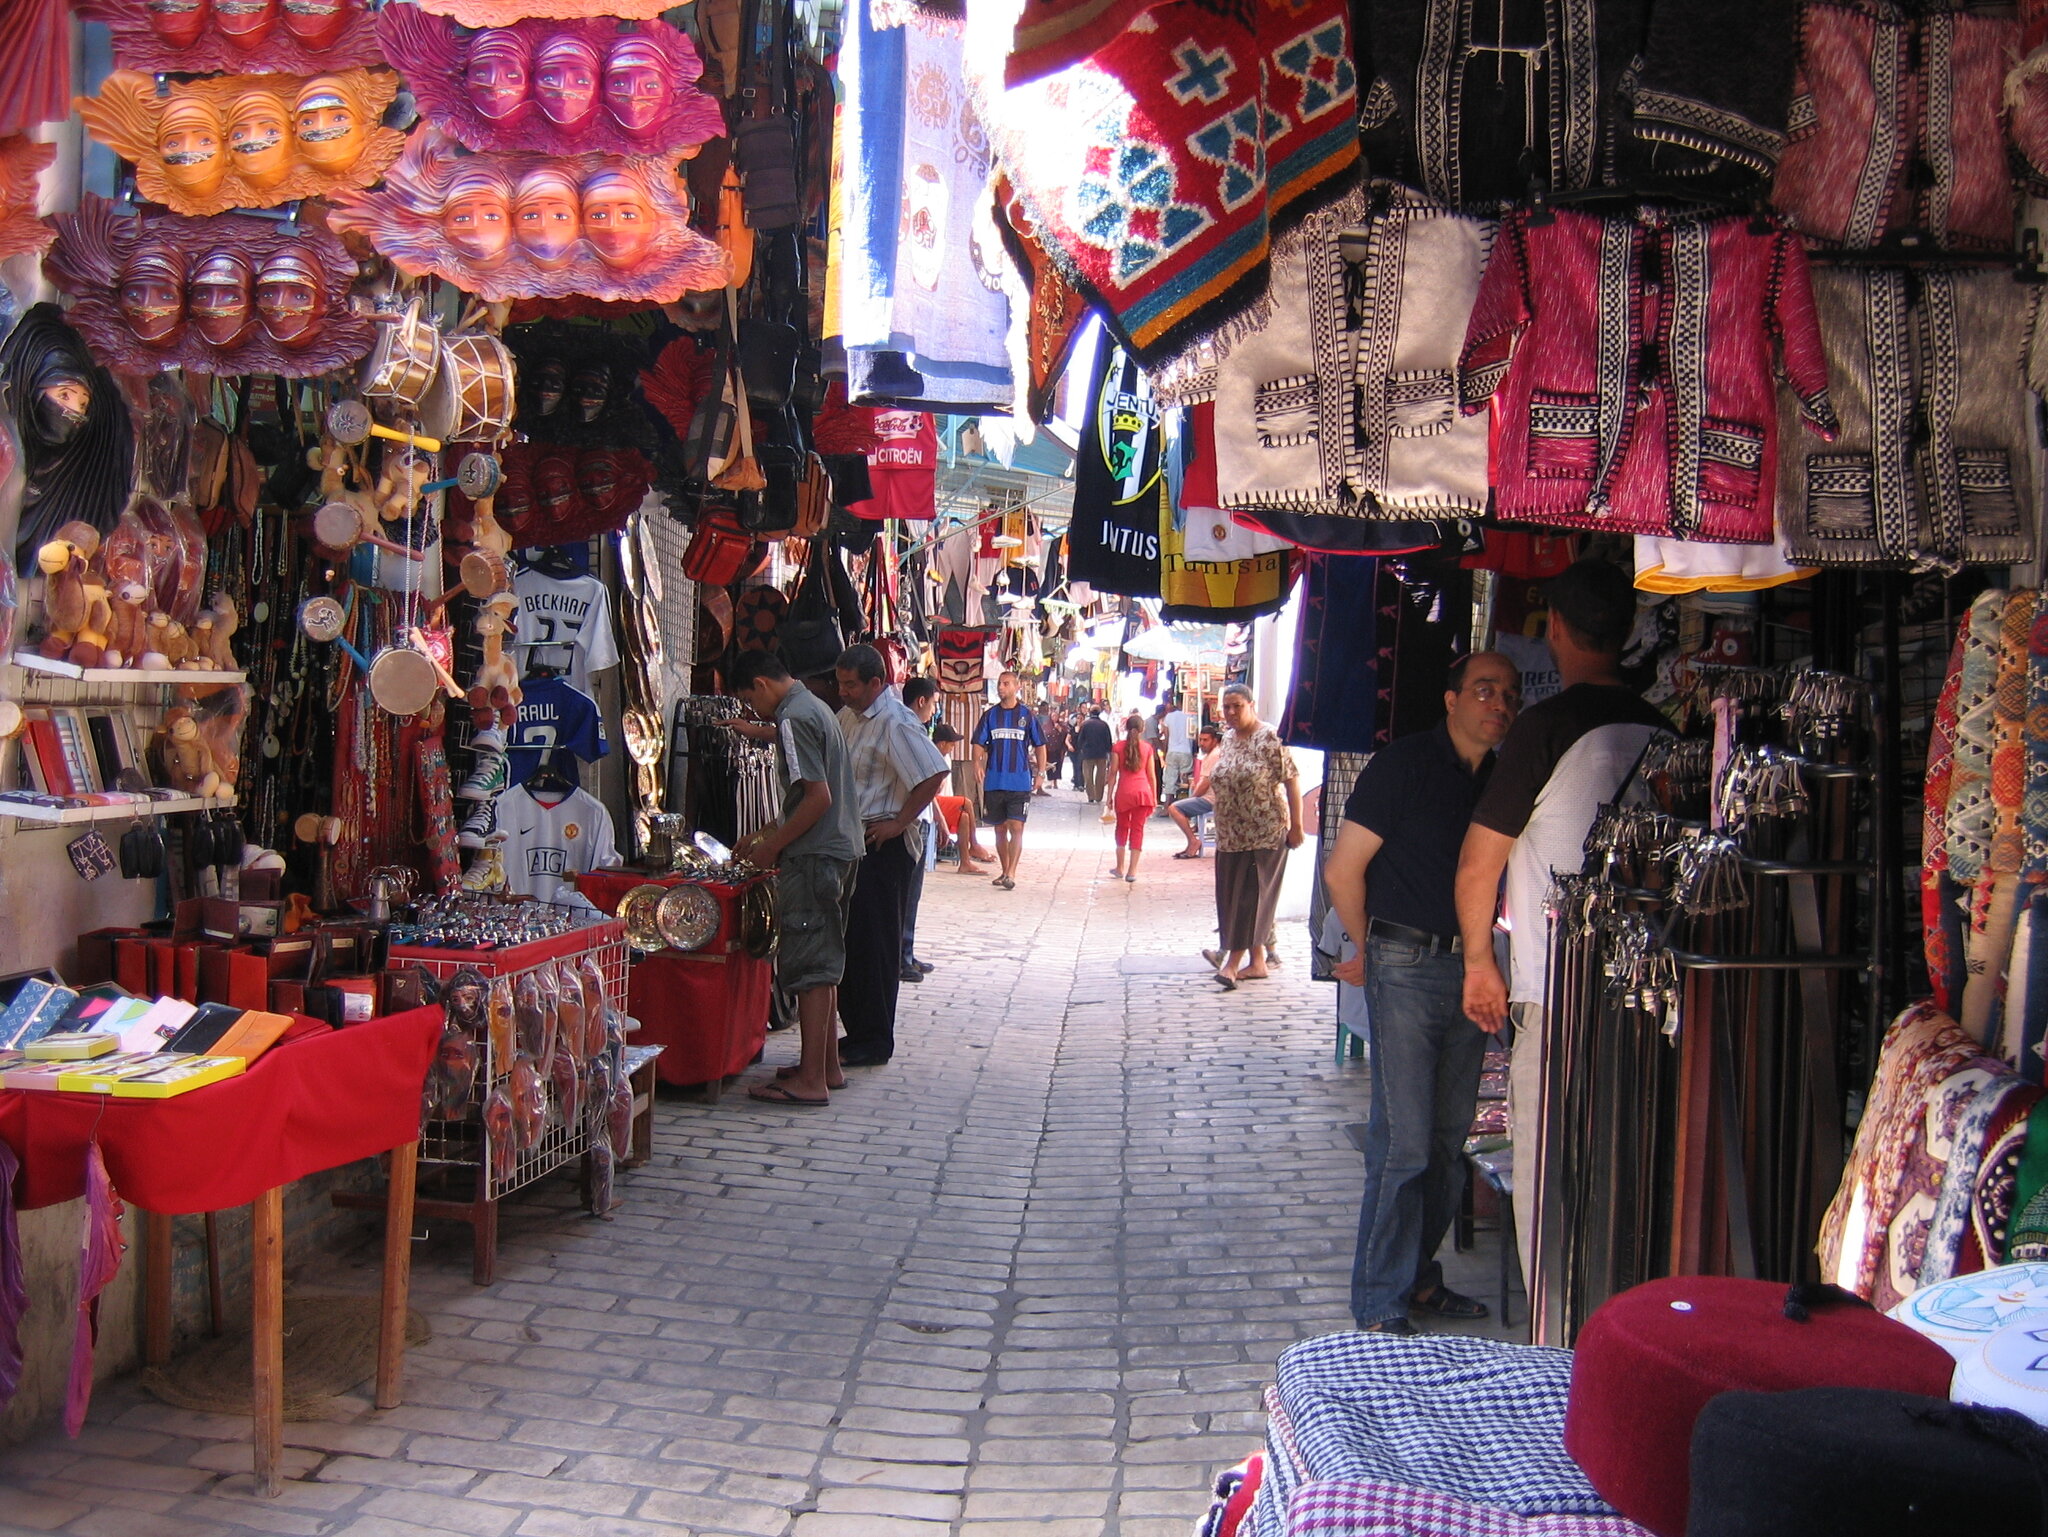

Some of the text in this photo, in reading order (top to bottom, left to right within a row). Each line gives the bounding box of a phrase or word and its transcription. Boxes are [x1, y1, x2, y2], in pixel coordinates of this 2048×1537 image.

[878, 447, 922, 464] CITROËN
[518, 702, 559, 721] RAUL
[523, 725, 558, 767] 7
[529, 851, 563, 873] AIG
